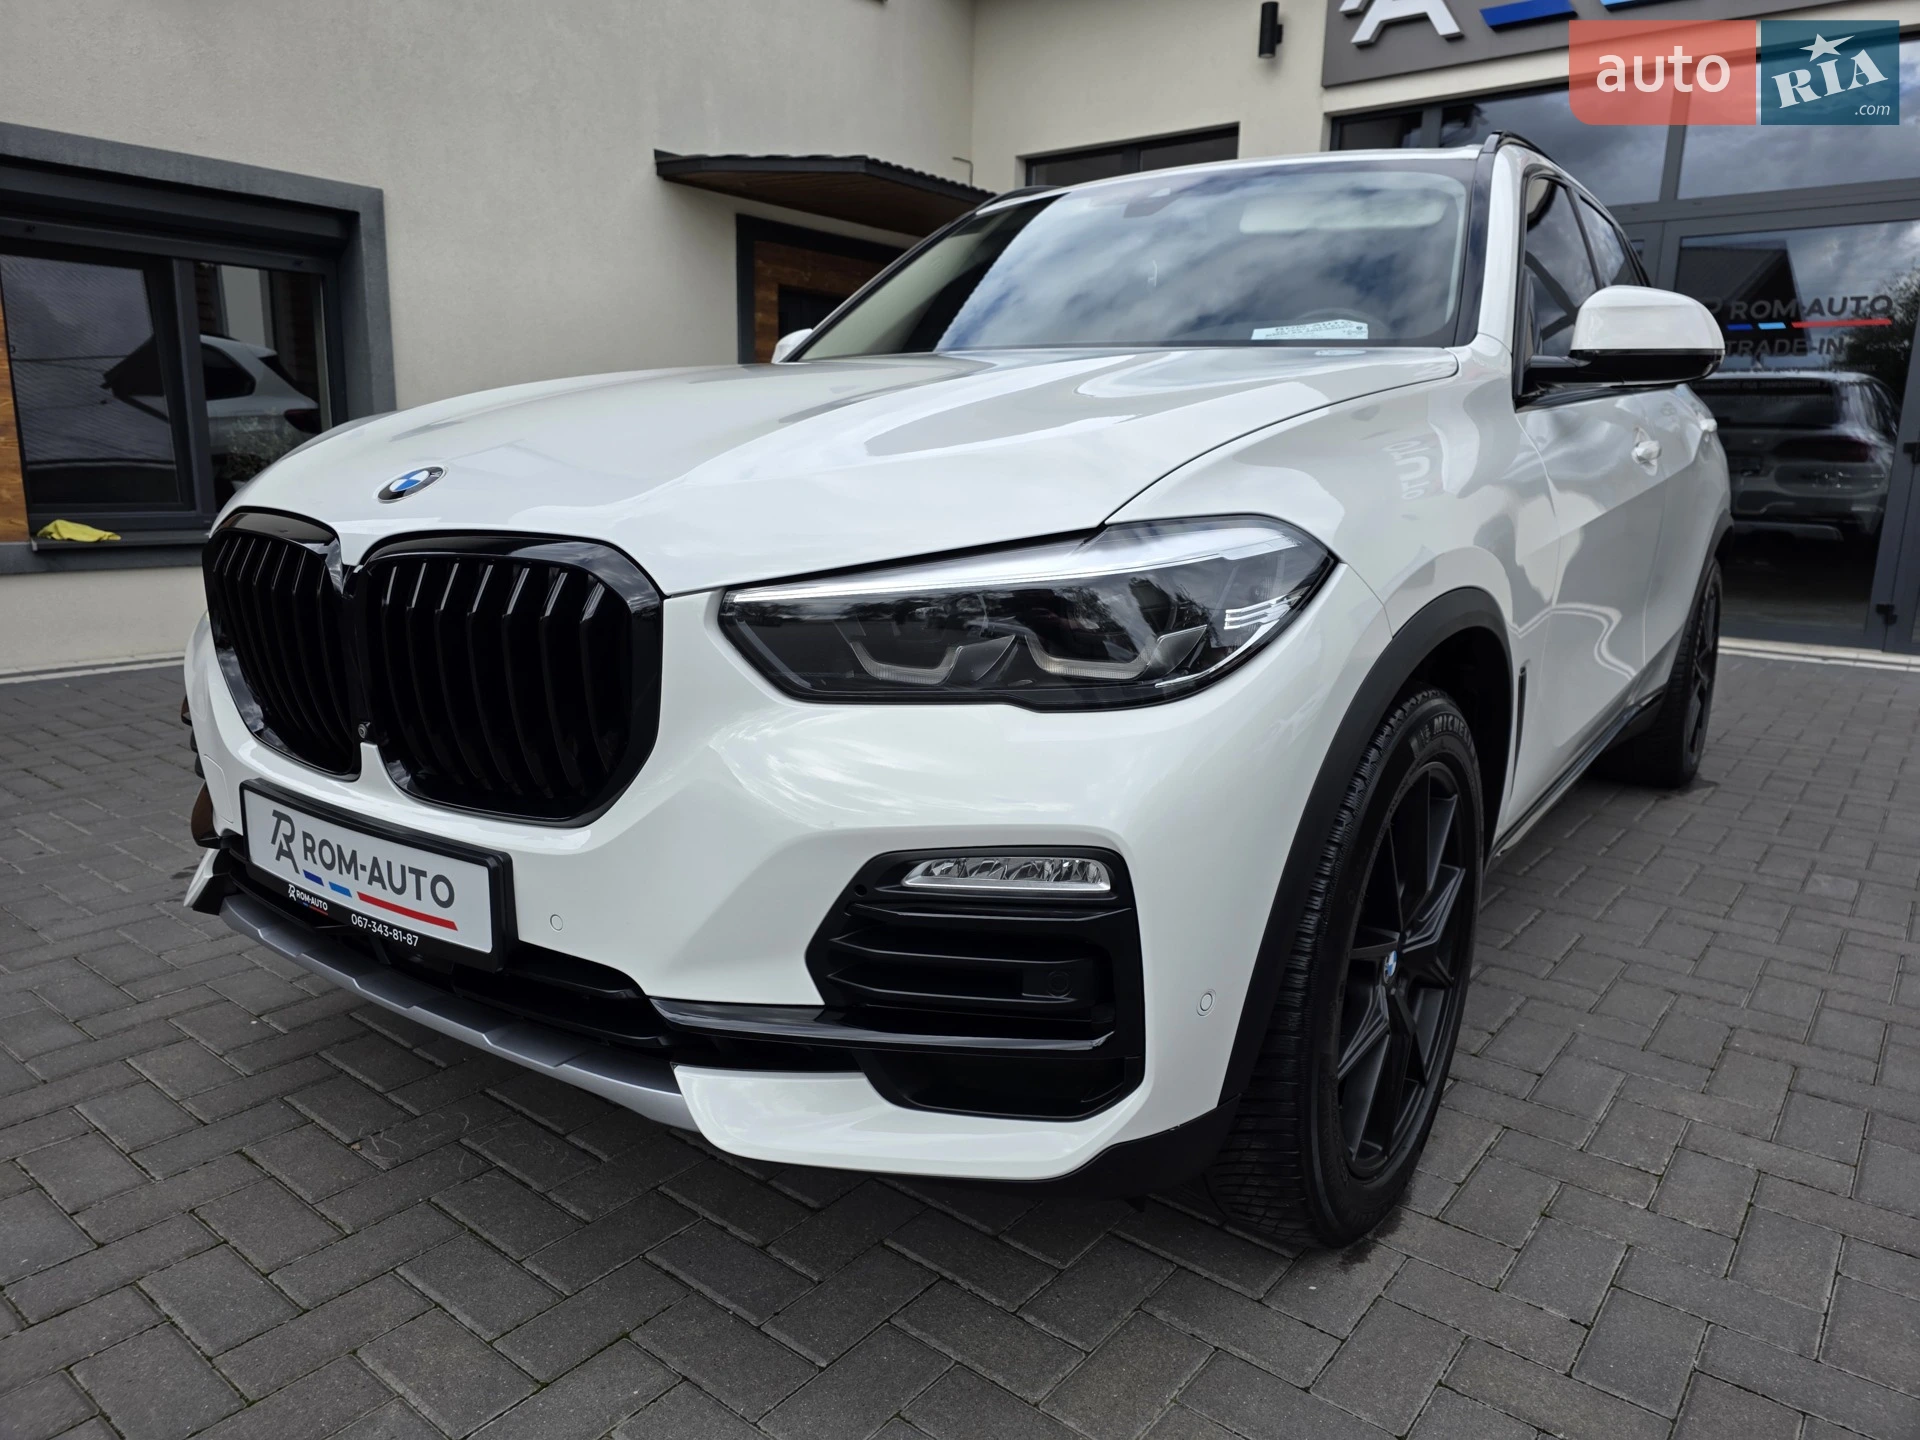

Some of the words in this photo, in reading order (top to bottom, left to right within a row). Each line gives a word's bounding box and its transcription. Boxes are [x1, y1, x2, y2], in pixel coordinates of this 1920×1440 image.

[1729, 294, 1894, 320] ROM-AUTO
[1725, 337, 1846, 358] TRADE-IN
[302, 830, 455, 909] ROM-AUTO
[296, 890, 328, 911] ROM-AUTO
[351, 913, 419, 947] 067-343-81-87
